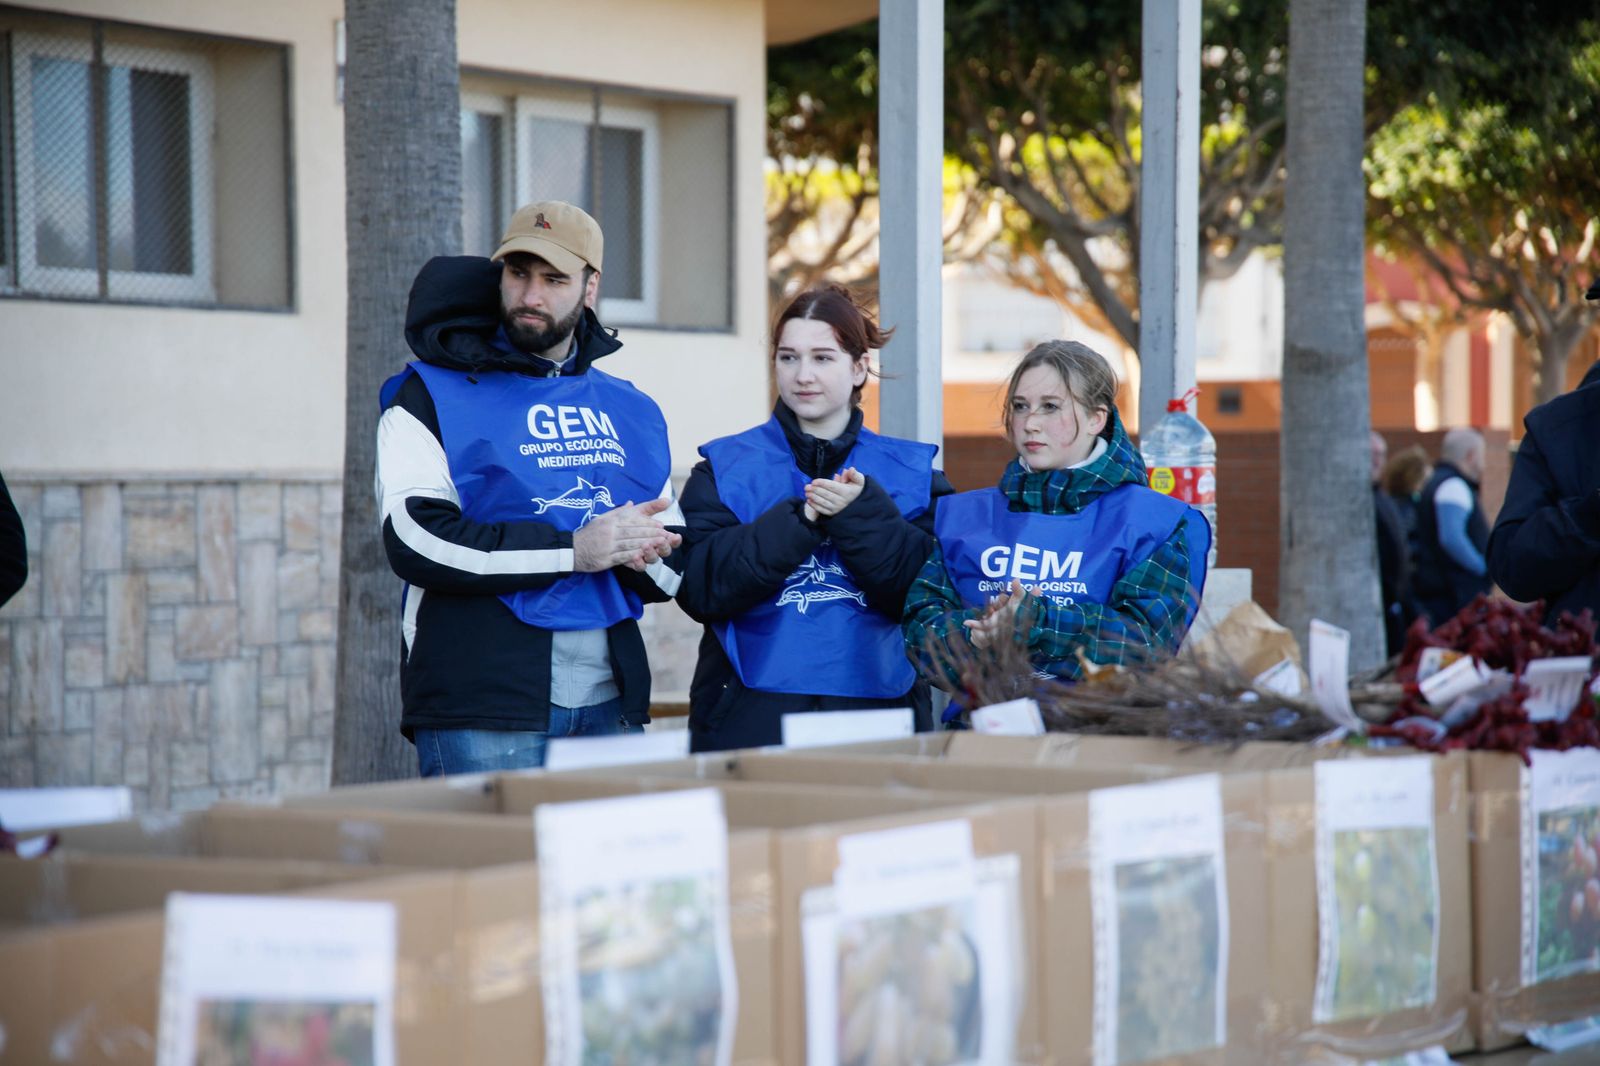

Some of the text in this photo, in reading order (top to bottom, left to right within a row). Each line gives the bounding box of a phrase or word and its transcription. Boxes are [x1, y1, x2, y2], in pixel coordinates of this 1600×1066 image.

[527, 404, 619, 440] GEM
[520, 443, 563, 455] GRUPO
[537, 451, 625, 468] MEDITERRÁNEO
[980, 543, 1083, 580] GEM
